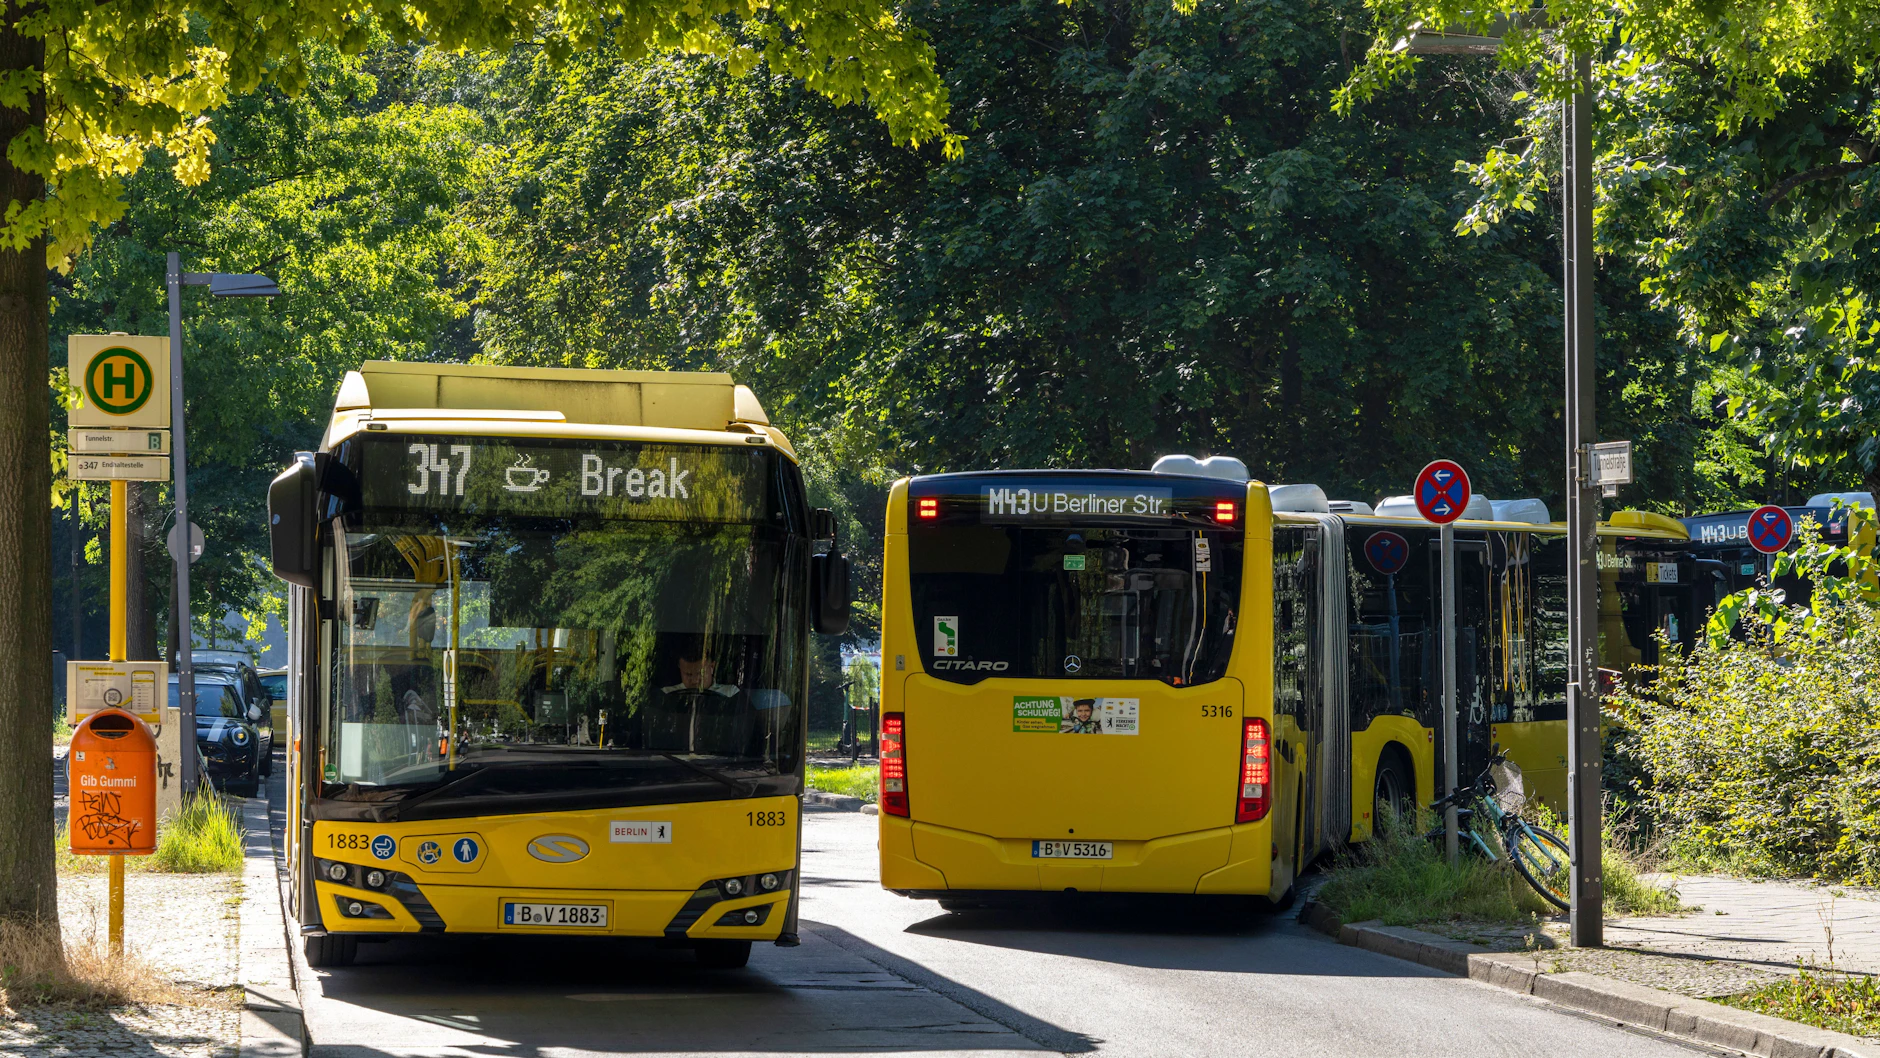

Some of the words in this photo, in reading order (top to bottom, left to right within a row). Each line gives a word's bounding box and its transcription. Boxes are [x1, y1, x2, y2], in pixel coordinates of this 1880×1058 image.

[103, 363, 135, 399] H
[150, 435, 160, 450] B
[83, 461, 99, 470] 347
[102, 461, 144, 469] Endhaltestelle
[408, 443, 471, 496] 347
[581, 454, 689, 499] Break
[989, 488, 1031, 515] M43
[1033, 492, 1049, 513] U
[1054, 493, 1127, 514] Berliner
[1133, 494, 1167, 515] Str.
[1701, 524, 1726, 544] M43
[1727, 526, 1736, 539] U
[1659, 564, 1677, 581] Tickets
[933, 660, 1009, 671] CITARO
[1014, 700, 1054, 710] ACHTUNG
[1017, 708, 1061, 717] SCHULWEG!
[1201, 705, 1233, 718] 5316
[80, 775, 97, 787] Gib
[100, 776, 137, 788] Gummi
[746, 811, 786, 827] 1883
[614, 828, 648, 836] BERLIN
[328, 833, 369, 850] 1883
[1073, 843, 1107, 857] 5316
[558, 907, 600, 924] 1883
